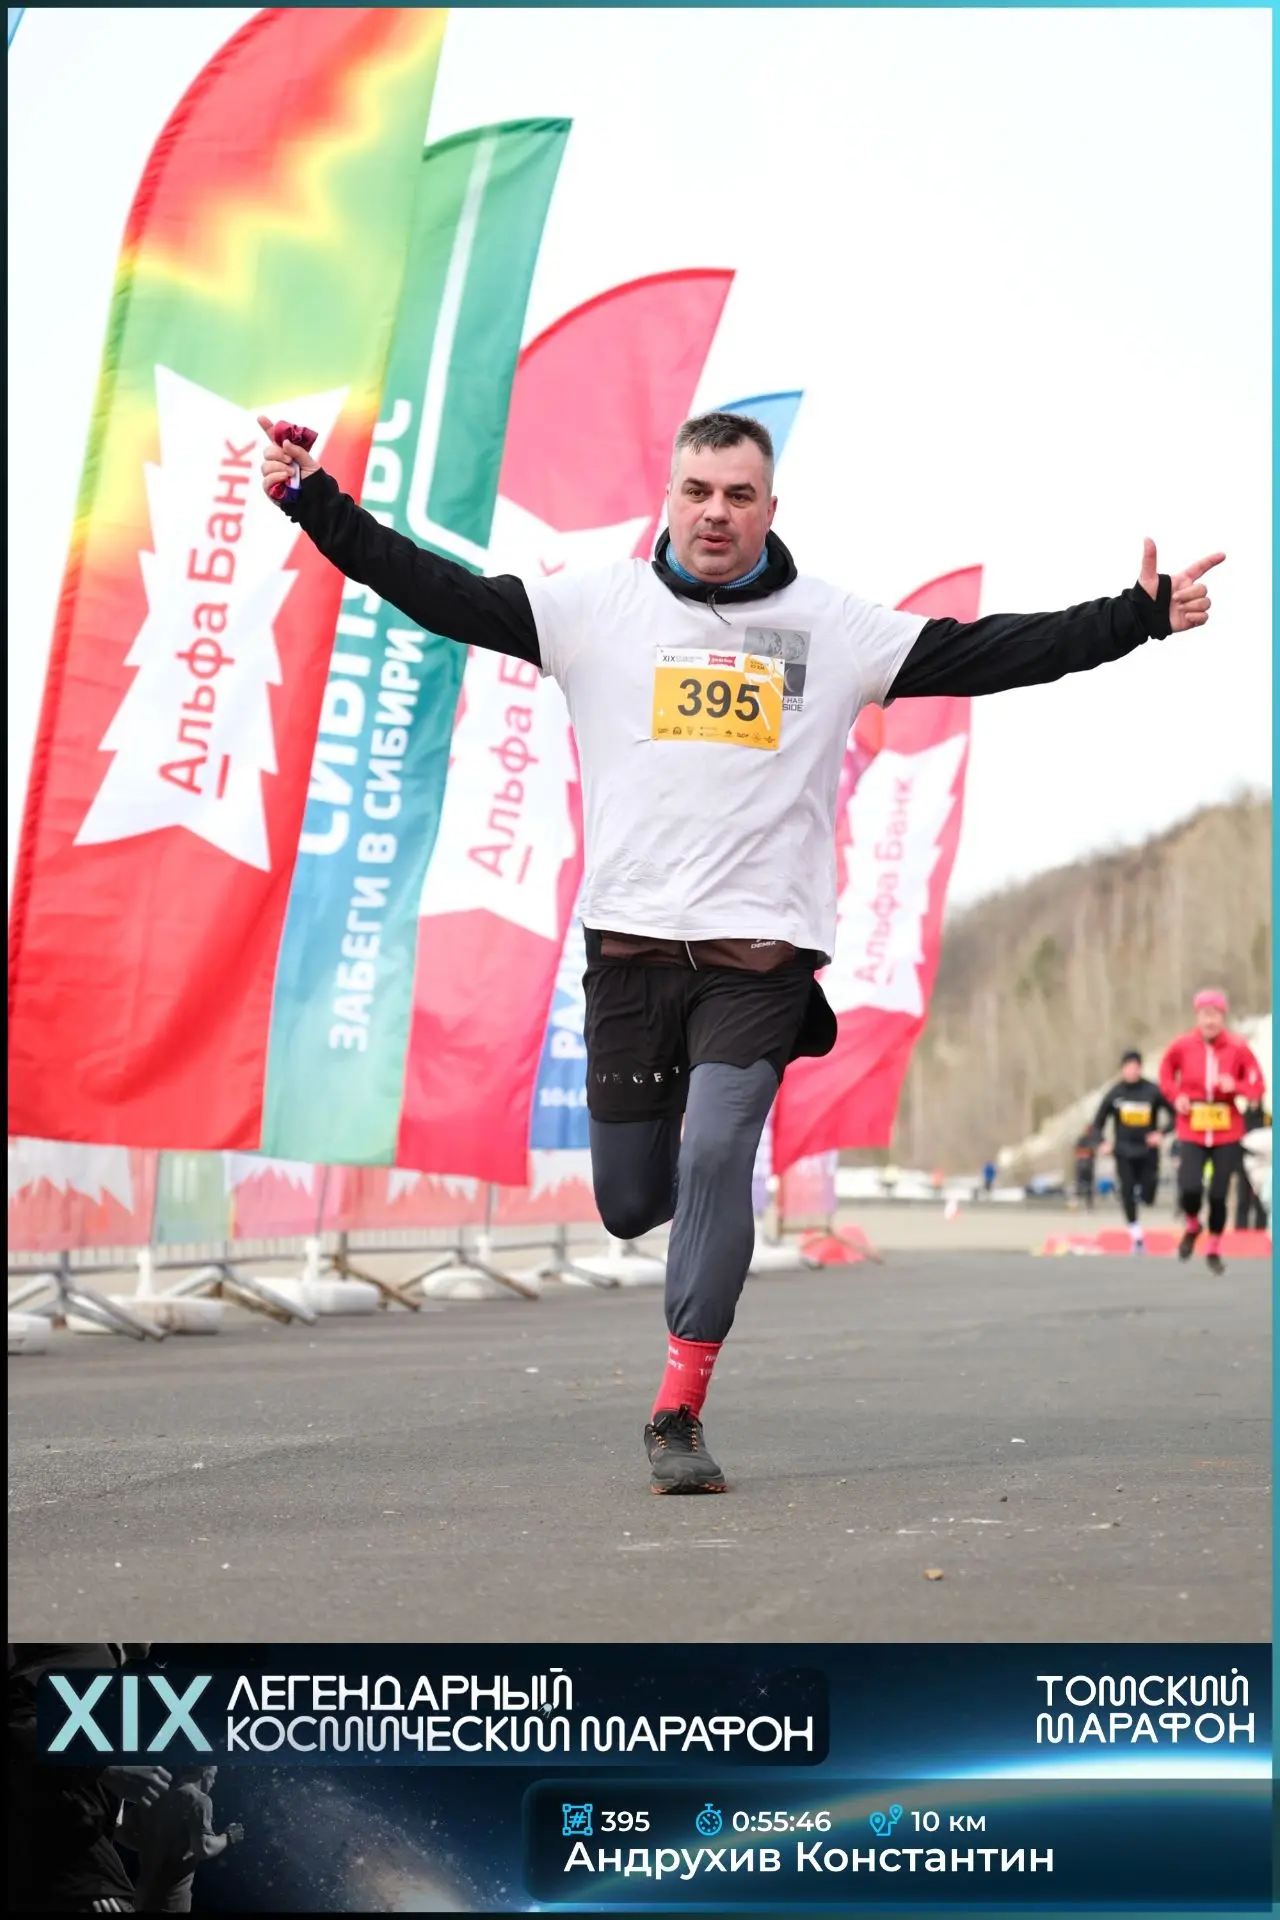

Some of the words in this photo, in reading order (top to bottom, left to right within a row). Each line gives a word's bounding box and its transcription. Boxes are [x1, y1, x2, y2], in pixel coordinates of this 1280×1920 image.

[187, 438, 259, 586] Банк
[157, 601, 236, 796] Альфа
[362, 627, 428, 820] СИБИРИ
[677, 678, 760, 723] 395
[782, 703, 804, 712] SIDE
[356, 832, 398, 864] В
[466, 704, 539, 880] Альфа
[874, 776, 916, 862] Банк
[328, 875, 392, 1053] ЗАБЕГИ
